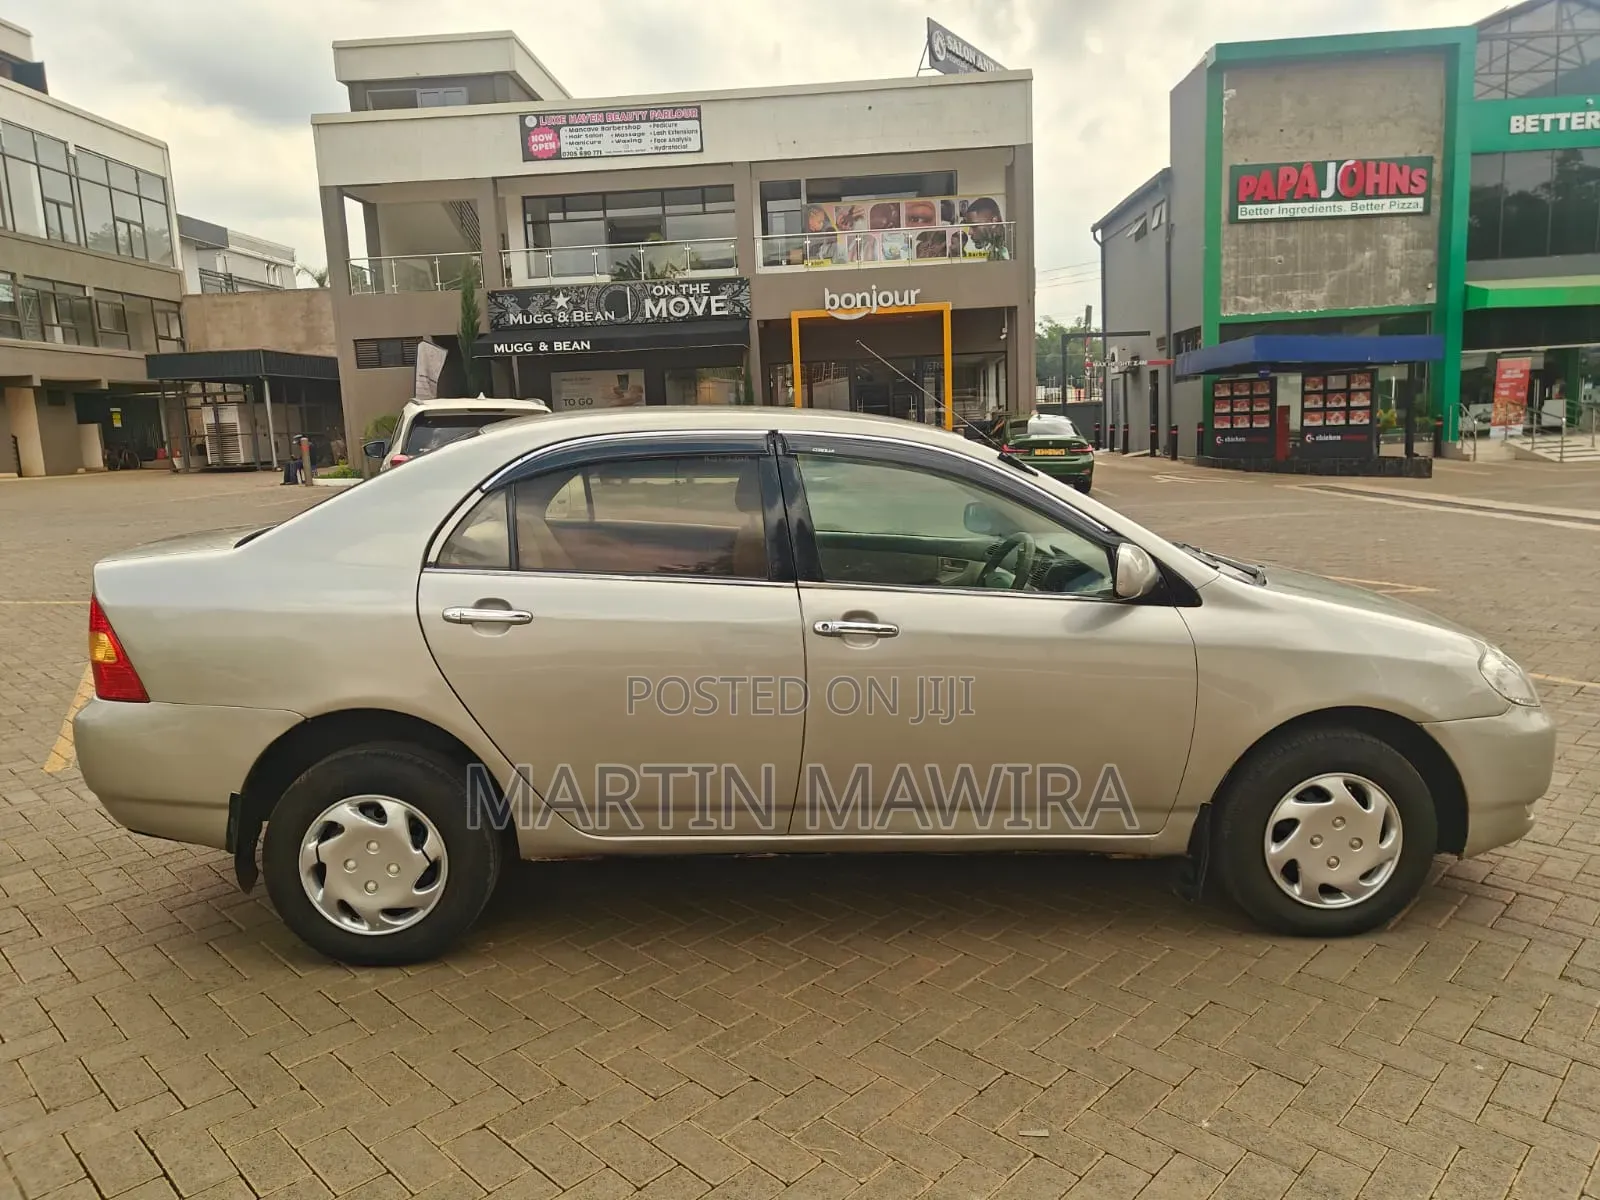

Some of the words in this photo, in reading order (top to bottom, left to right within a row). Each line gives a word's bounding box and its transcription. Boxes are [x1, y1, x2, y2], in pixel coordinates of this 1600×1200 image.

[945, 35, 976, 65] SALON
[540, 115, 567, 126] LUXE
[568, 112, 604, 124] HAVEN
[606, 110, 648, 122] BEAUTY
[649, 108, 698, 120] PARLOUR
[1510, 111, 1600, 134] BETTER
[600, 124, 642, 132] Barbershop
[531, 133, 553, 143] NOW
[532, 142, 556, 152] OPEN
[1237, 162, 1319, 203] PAPA
[1320, 159, 1428, 199] JOHNS
[1239, 205, 1274, 217] Better
[1277, 203, 1346, 217] Ingredients.
[1350, 201, 1385, 212] Better
[1389, 199, 1422, 210] Pizza.
[652, 285, 676, 296] ON
[680, 283, 711, 295] THE
[644, 294, 729, 319] MOVE
[824, 284, 921, 314] bonjour
[558, 311, 571, 323] &
[493, 342, 534, 353] MUGG
[538, 341, 549, 352] &
[553, 340, 591, 351] BEAN
[562, 398, 576, 406] TO
[578, 397, 594, 406] GO
